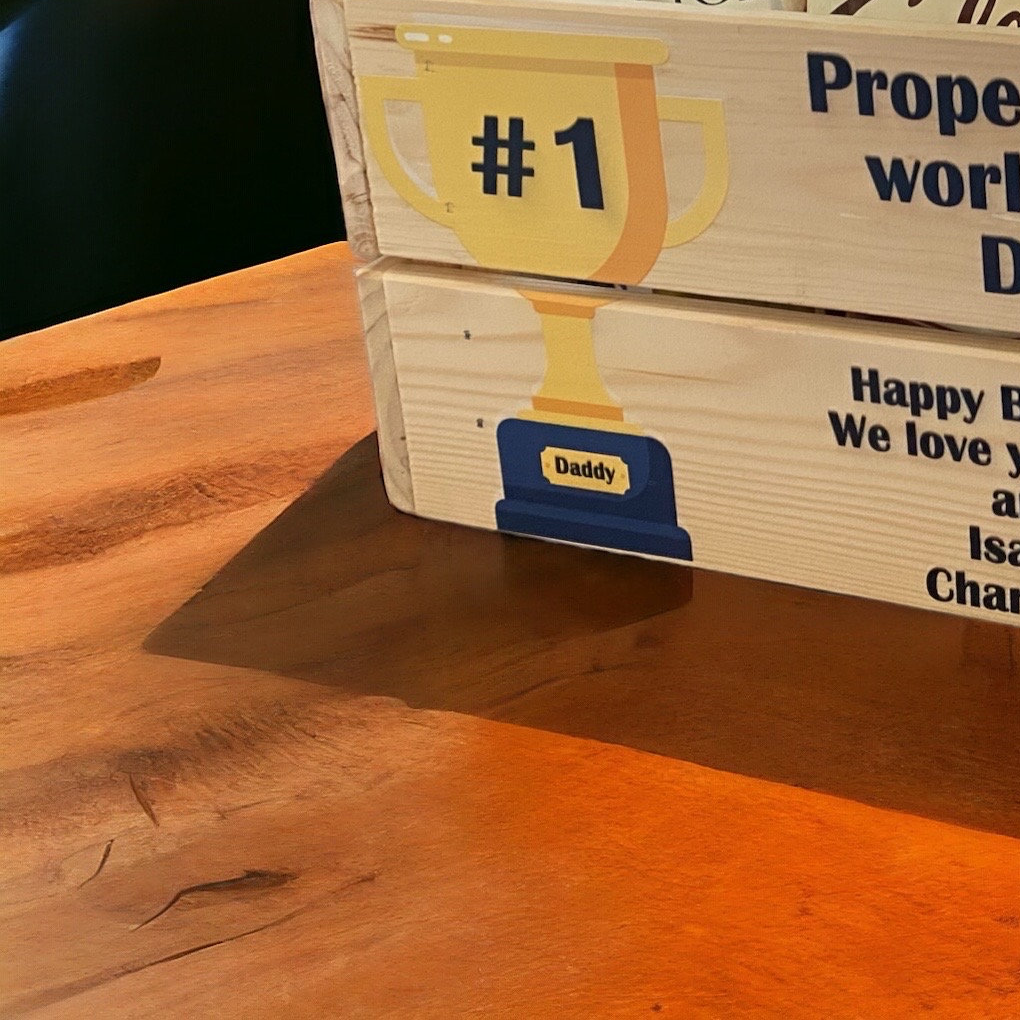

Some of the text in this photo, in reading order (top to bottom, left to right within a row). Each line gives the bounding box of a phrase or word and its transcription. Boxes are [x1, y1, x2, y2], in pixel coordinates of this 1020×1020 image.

[471, 115, 605, 211] #1
[851, 367, 984, 425] Happy
[827, 411, 891, 452] We
[905, 421, 991, 466] love
[554, 456, 616, 484] Daddy
